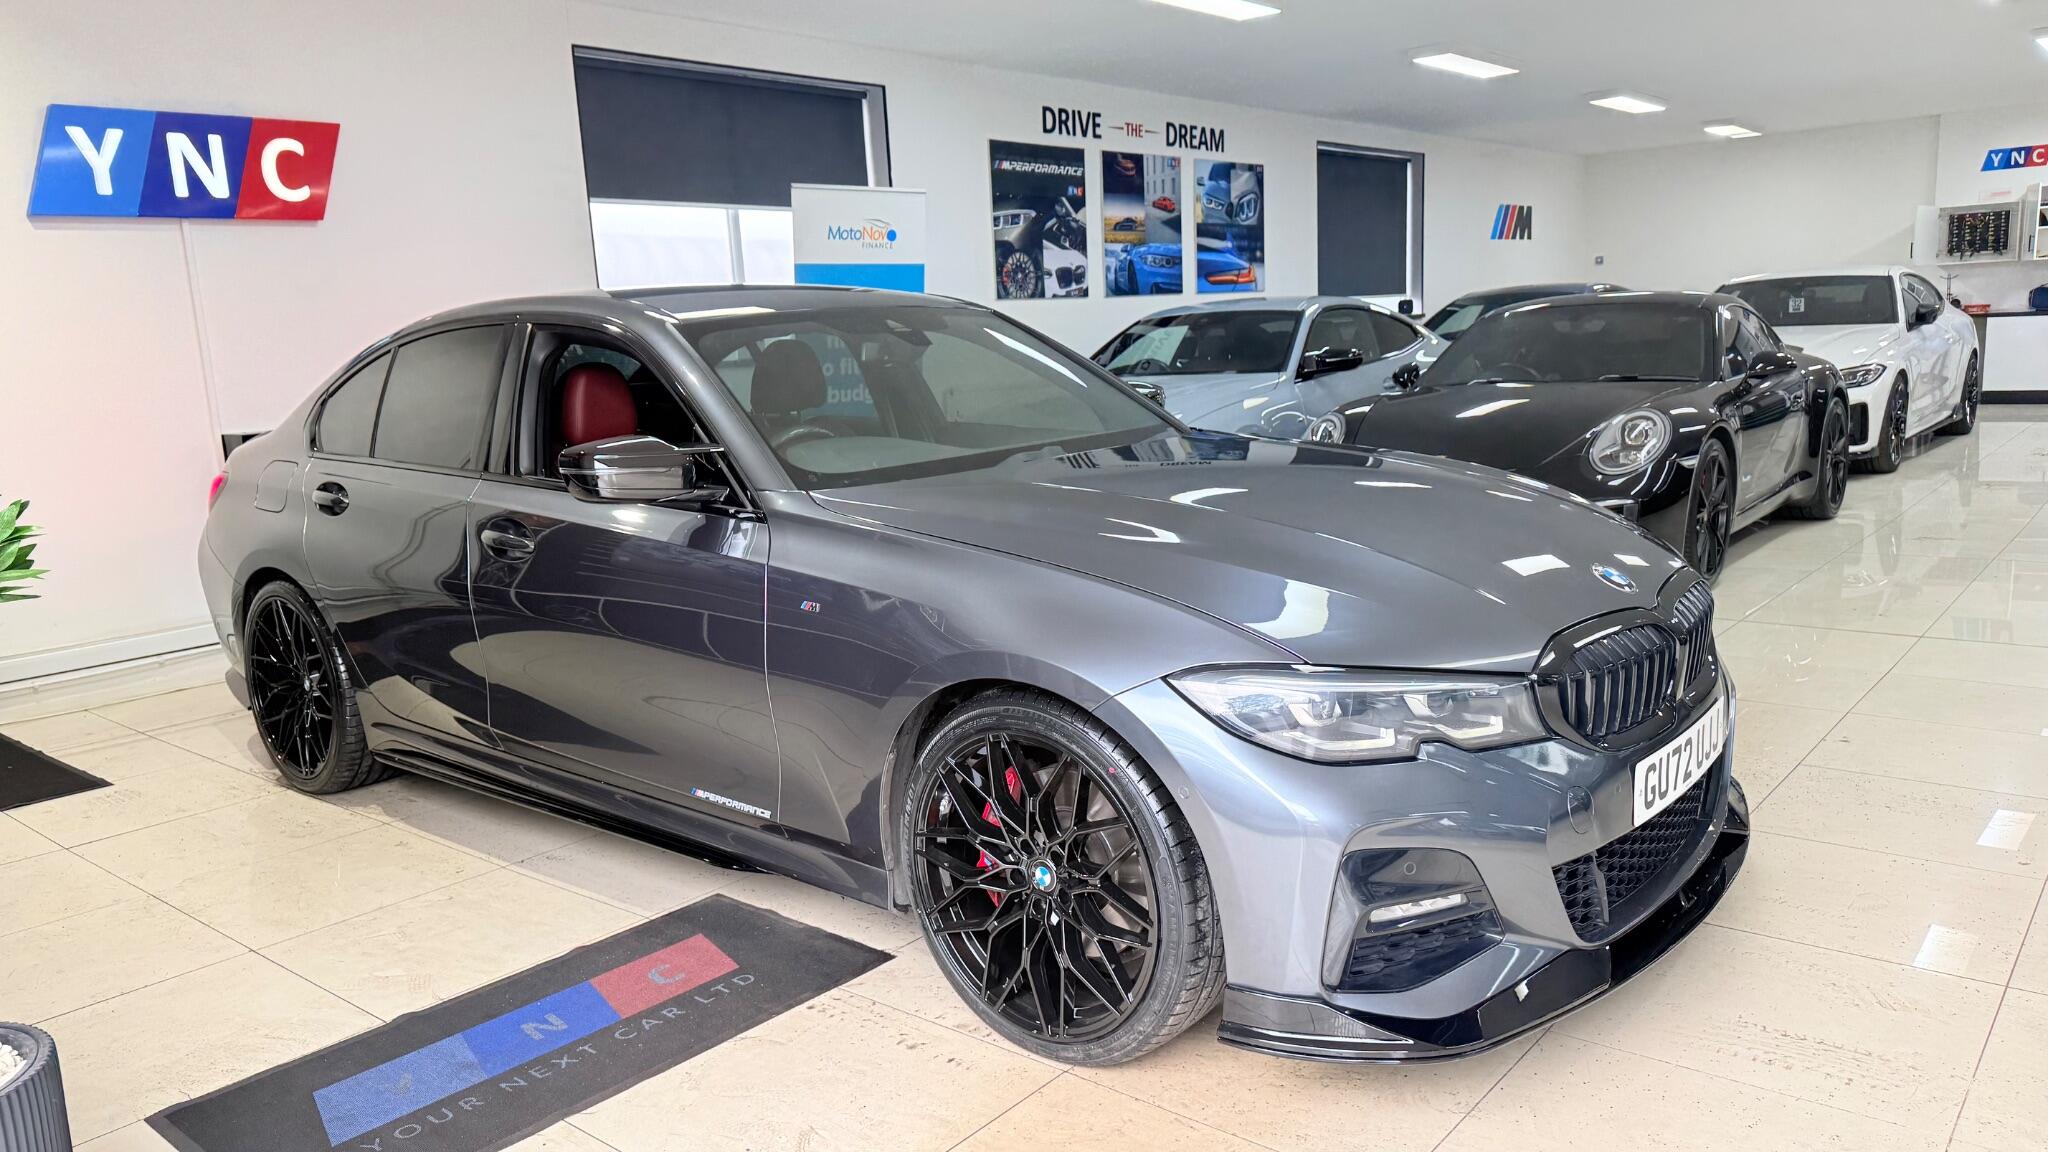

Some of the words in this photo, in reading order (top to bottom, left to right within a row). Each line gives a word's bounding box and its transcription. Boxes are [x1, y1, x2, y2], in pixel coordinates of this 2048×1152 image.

[1042, 105, 1102, 139] DRIVE
[1125, 122, 1143, 138] THE
[1166, 121, 1225, 152] DREAM
[1990, 148, 2045, 167] YNC
[64, 125, 311, 203] YNC
[861, 242, 894, 250] FINANCE
[1644, 736, 1693, 811] GU72
[1696, 707, 1720, 770] UJJ
[360, 1096, 484, 1152] YOUR
[498, 1042, 598, 1092] NEXT
[614, 1006, 686, 1040] CAR
[694, 973, 755, 1004] LTD
